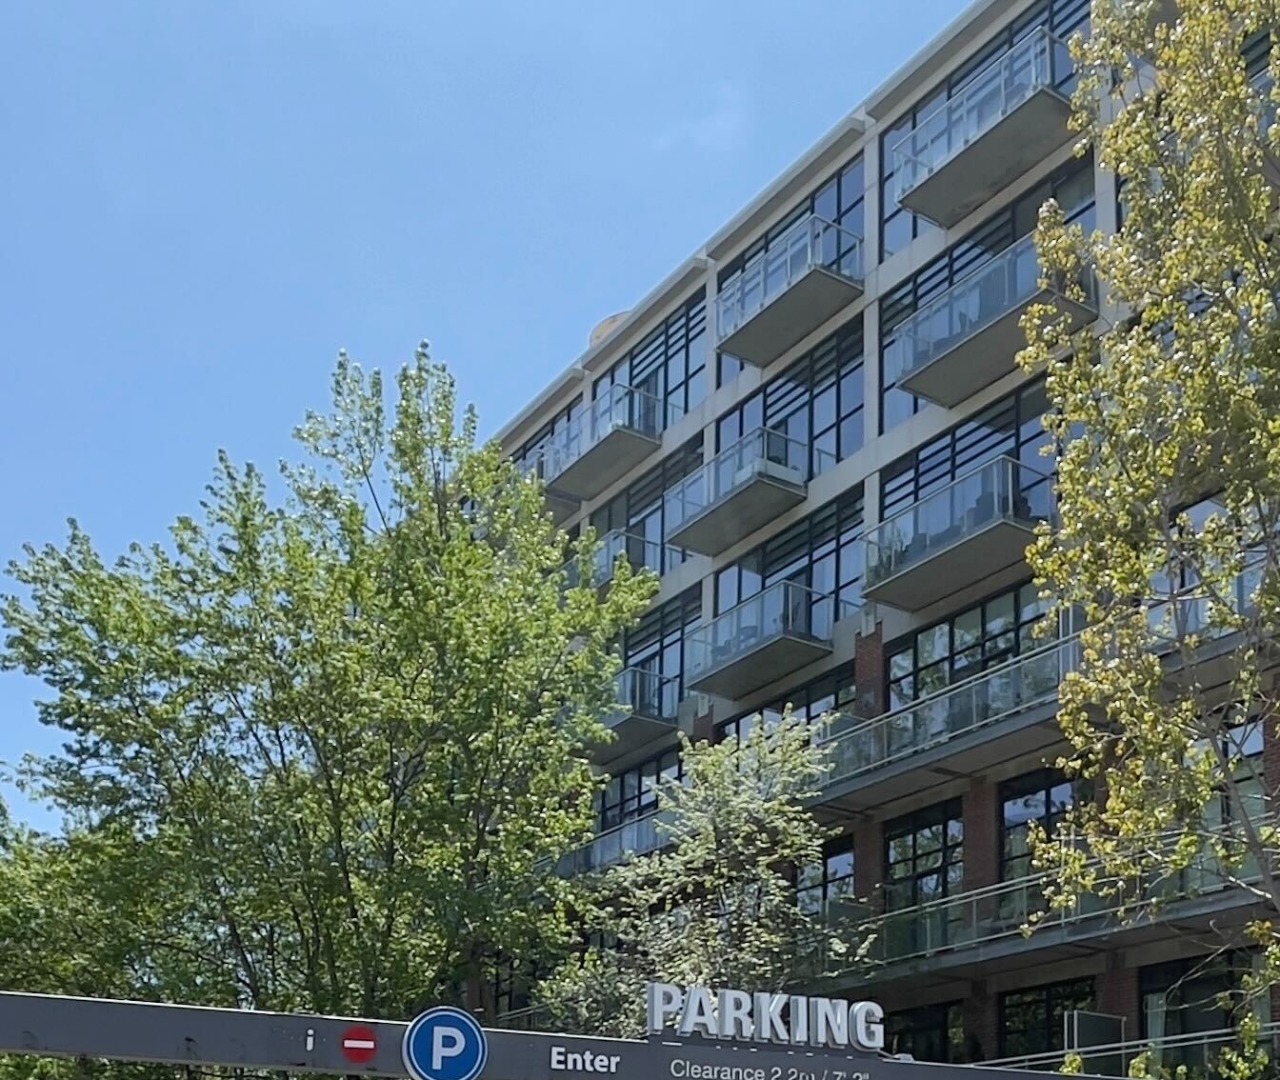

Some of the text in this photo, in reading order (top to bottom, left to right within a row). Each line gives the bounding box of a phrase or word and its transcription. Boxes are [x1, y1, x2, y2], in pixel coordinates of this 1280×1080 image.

[647, 983, 885, 1049] PARKING
[432, 1026, 466, 1070] P
[550, 1046, 620, 1073] Enter
